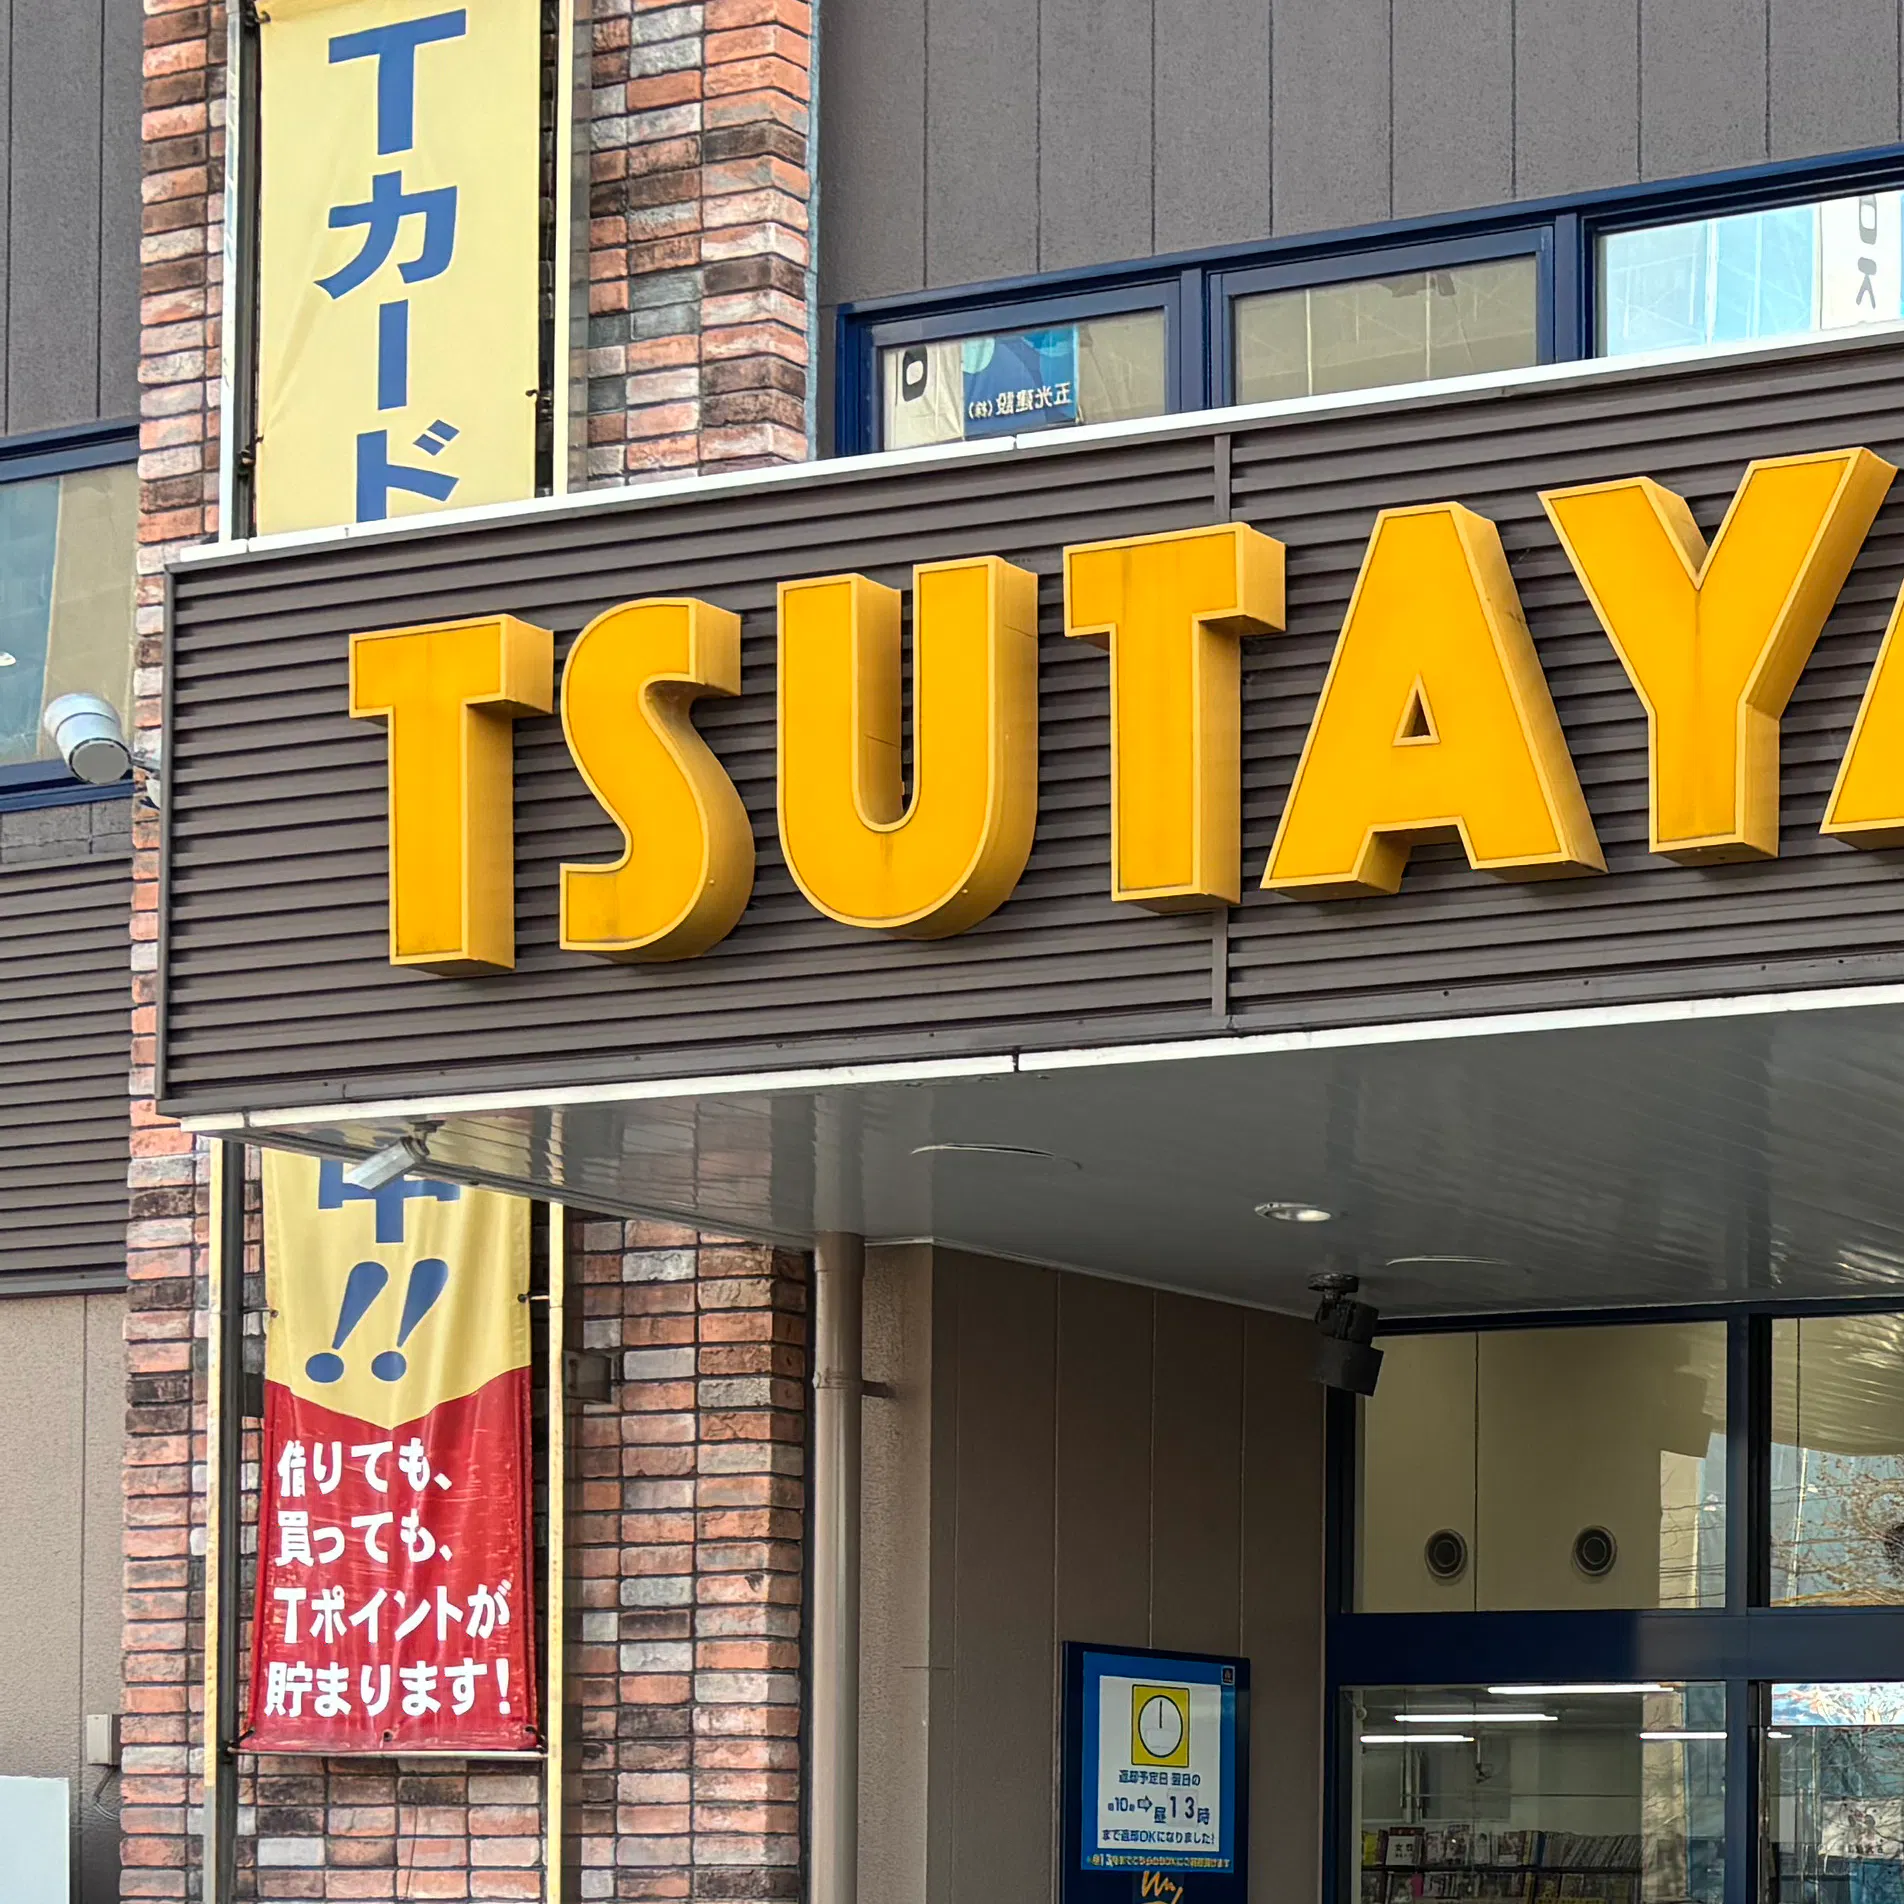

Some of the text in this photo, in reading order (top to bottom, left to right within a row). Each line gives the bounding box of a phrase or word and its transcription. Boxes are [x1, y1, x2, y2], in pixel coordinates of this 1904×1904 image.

[277, 1436, 453, 1498] 借りても、
[274, 1509, 453, 1567] 買っても、
[282, 1580, 514, 1645] Tポイントが
[264, 1656, 512, 1718] 貯まります!
